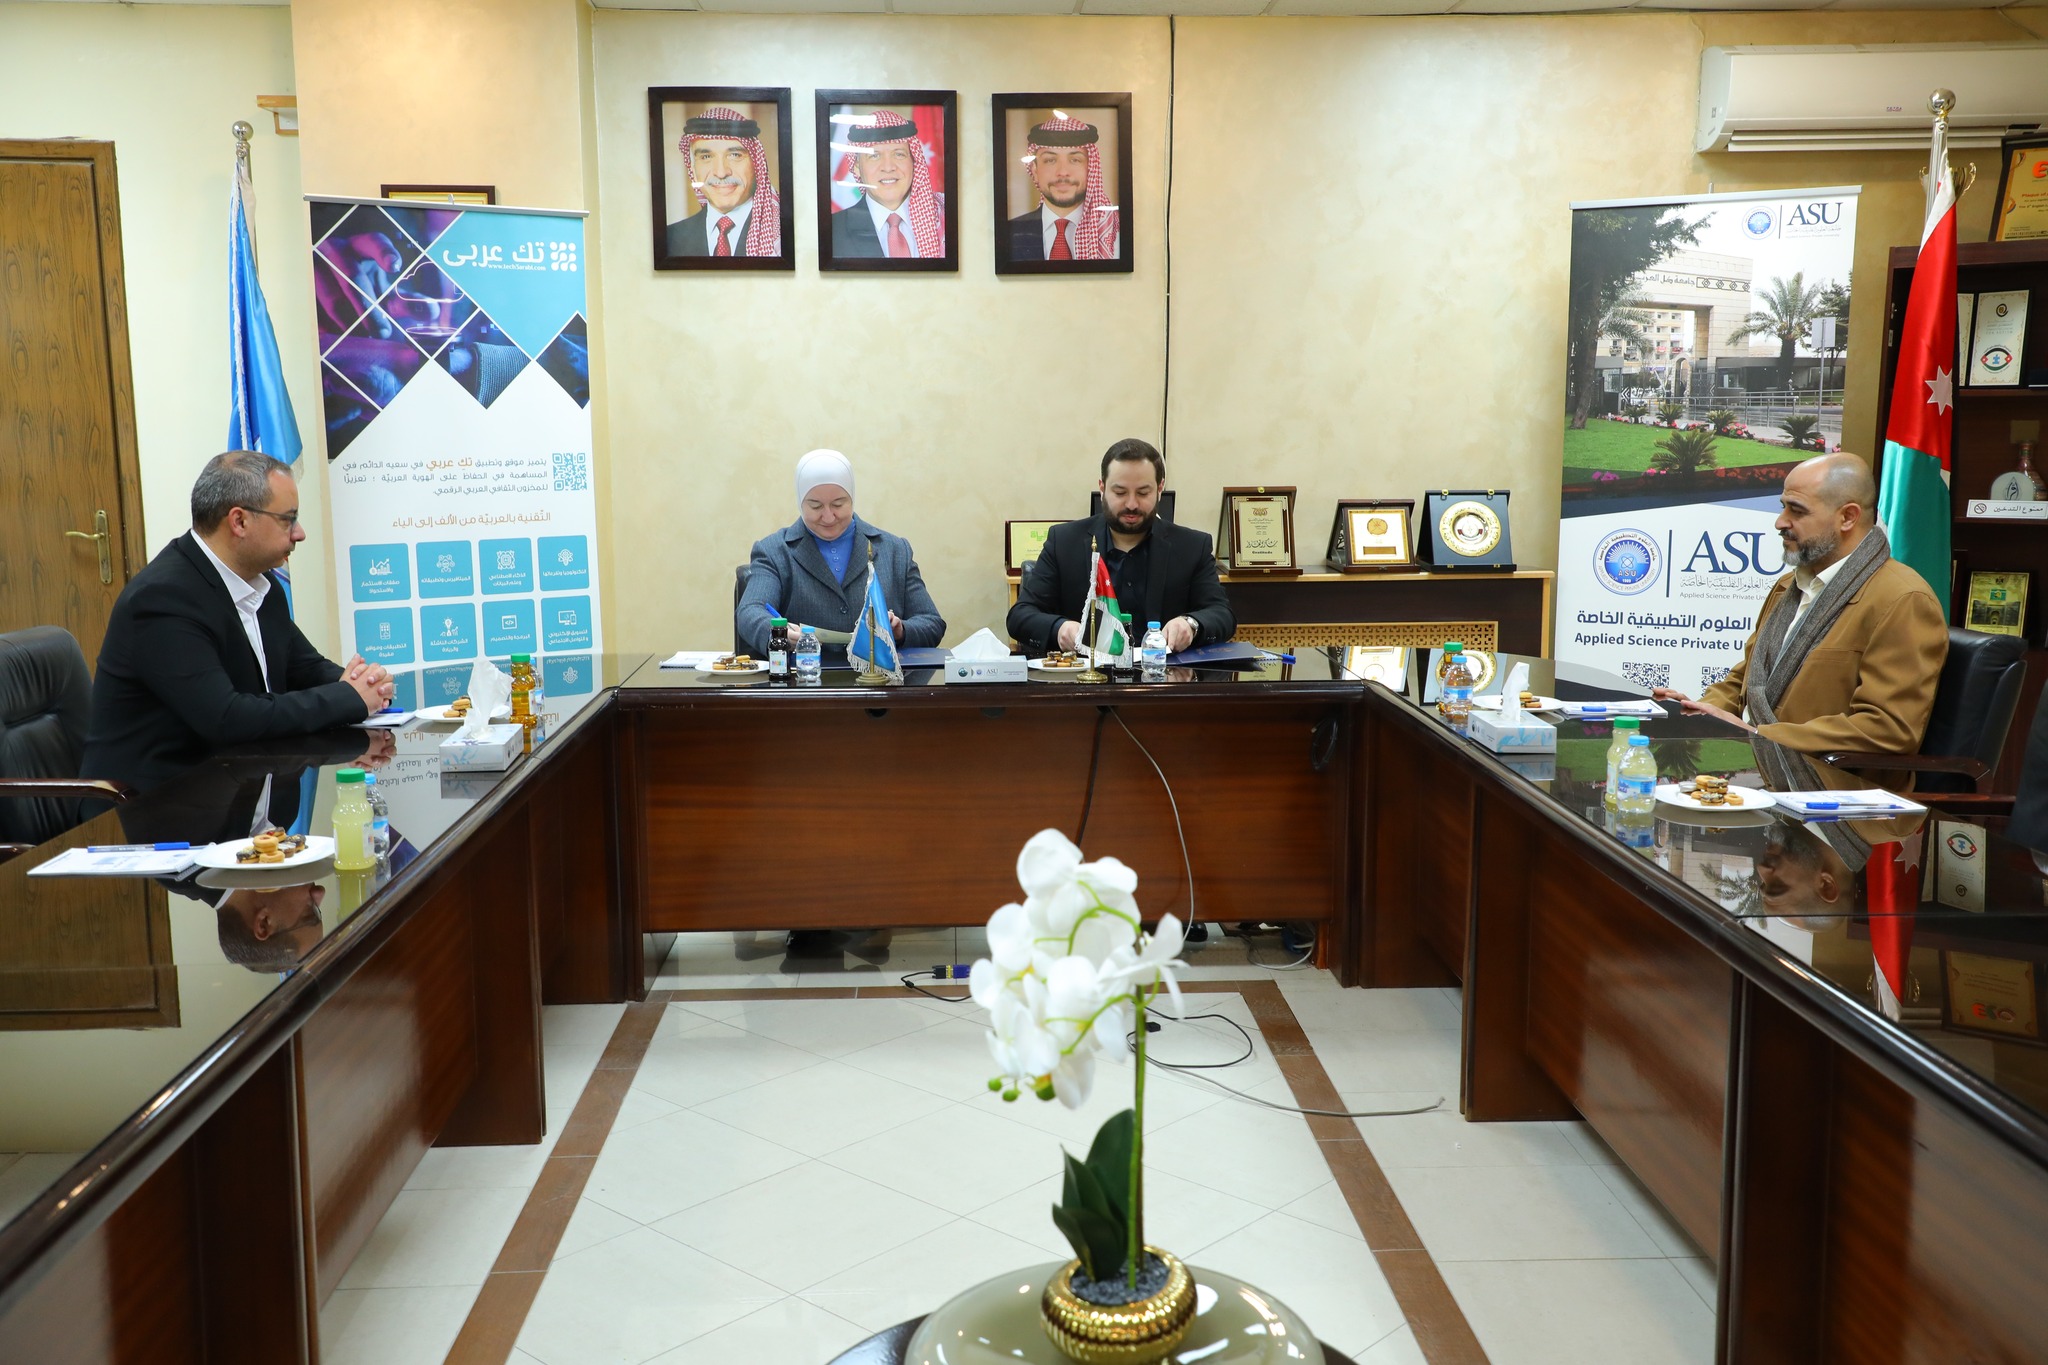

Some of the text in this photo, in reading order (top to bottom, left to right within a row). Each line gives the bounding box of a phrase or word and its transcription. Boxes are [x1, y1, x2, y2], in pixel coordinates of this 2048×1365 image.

[1786, 202, 1843, 226] ASU
[512, 241, 545, 264] تك
[342, 462, 357, 472] في
[360, 459, 384, 470] الدائم
[386, 461, 408, 470] سعيه
[410, 460, 424, 470] في
[426, 459, 454, 471] عربي
[475, 459, 502, 468] وتطبيق
[505, 459, 524, 468] موقع
[527, 458, 547, 467] يتميز
[412, 473, 435, 482] الهوية
[439, 473, 457, 482] على
[463, 472, 488, 480] الحفاظ
[492, 472, 505, 481] في
[509, 471, 548, 479] المساهمة
[463, 485, 488, 495] العربي
[488, 484, 516, 495] الثقافي
[516, 484, 549, 493] للمخزون
[392, 517, 413, 528] الياء
[434, 513, 457, 526] الألف
[459, 516, 476, 527] من
[1681, 530, 1786, 576] ASU
[1680, 592, 1705, 600] Applied
[1706, 592, 1730, 600] Science
[1577, 610, 1751, 632] العلوم التطبيقية الخاصة
[1574, 632, 1624, 646] Applied
[1628, 635, 1678, 648] Science
[1681, 637, 1730, 650] Private
